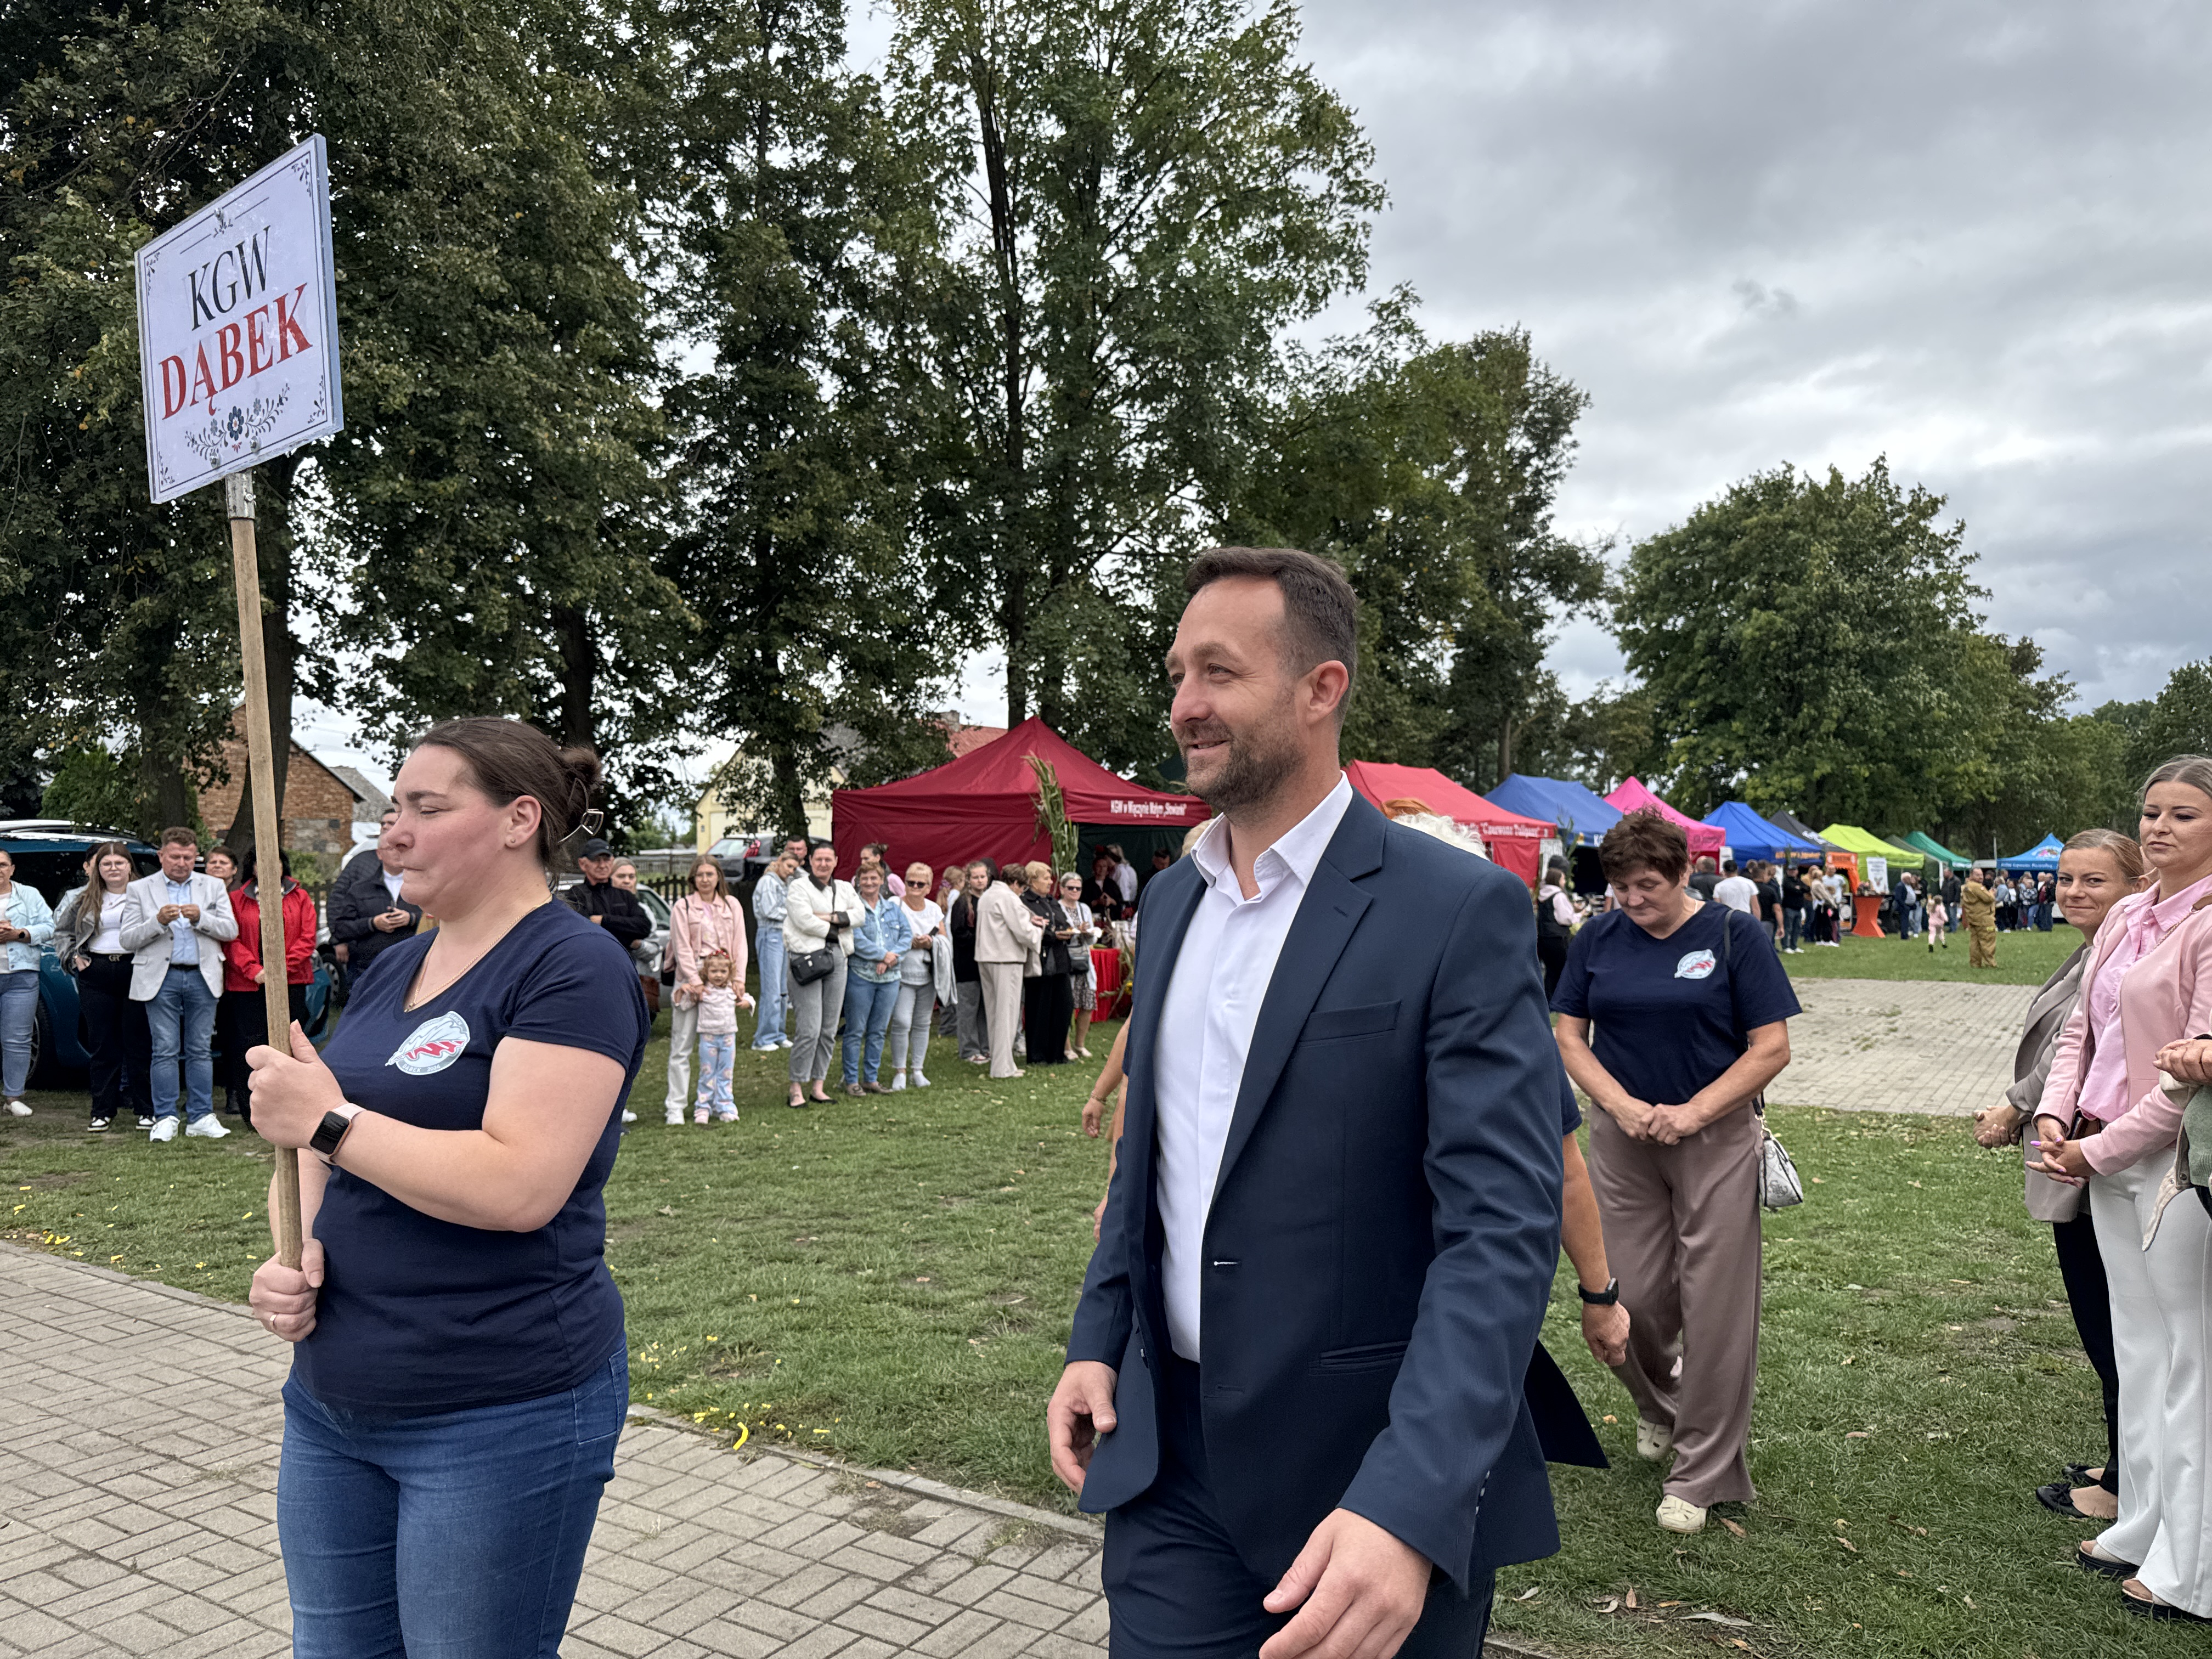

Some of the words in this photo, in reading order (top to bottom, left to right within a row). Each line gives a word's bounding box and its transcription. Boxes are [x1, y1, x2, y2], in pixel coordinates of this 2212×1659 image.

[187, 225, 270, 331] KGW
[158, 282, 313, 421] DĄBEK
[1110, 799, 1124, 814] KGW
[402, 1064, 421, 1073] DĄBEK
[427, 1064, 441, 1072] 2024
